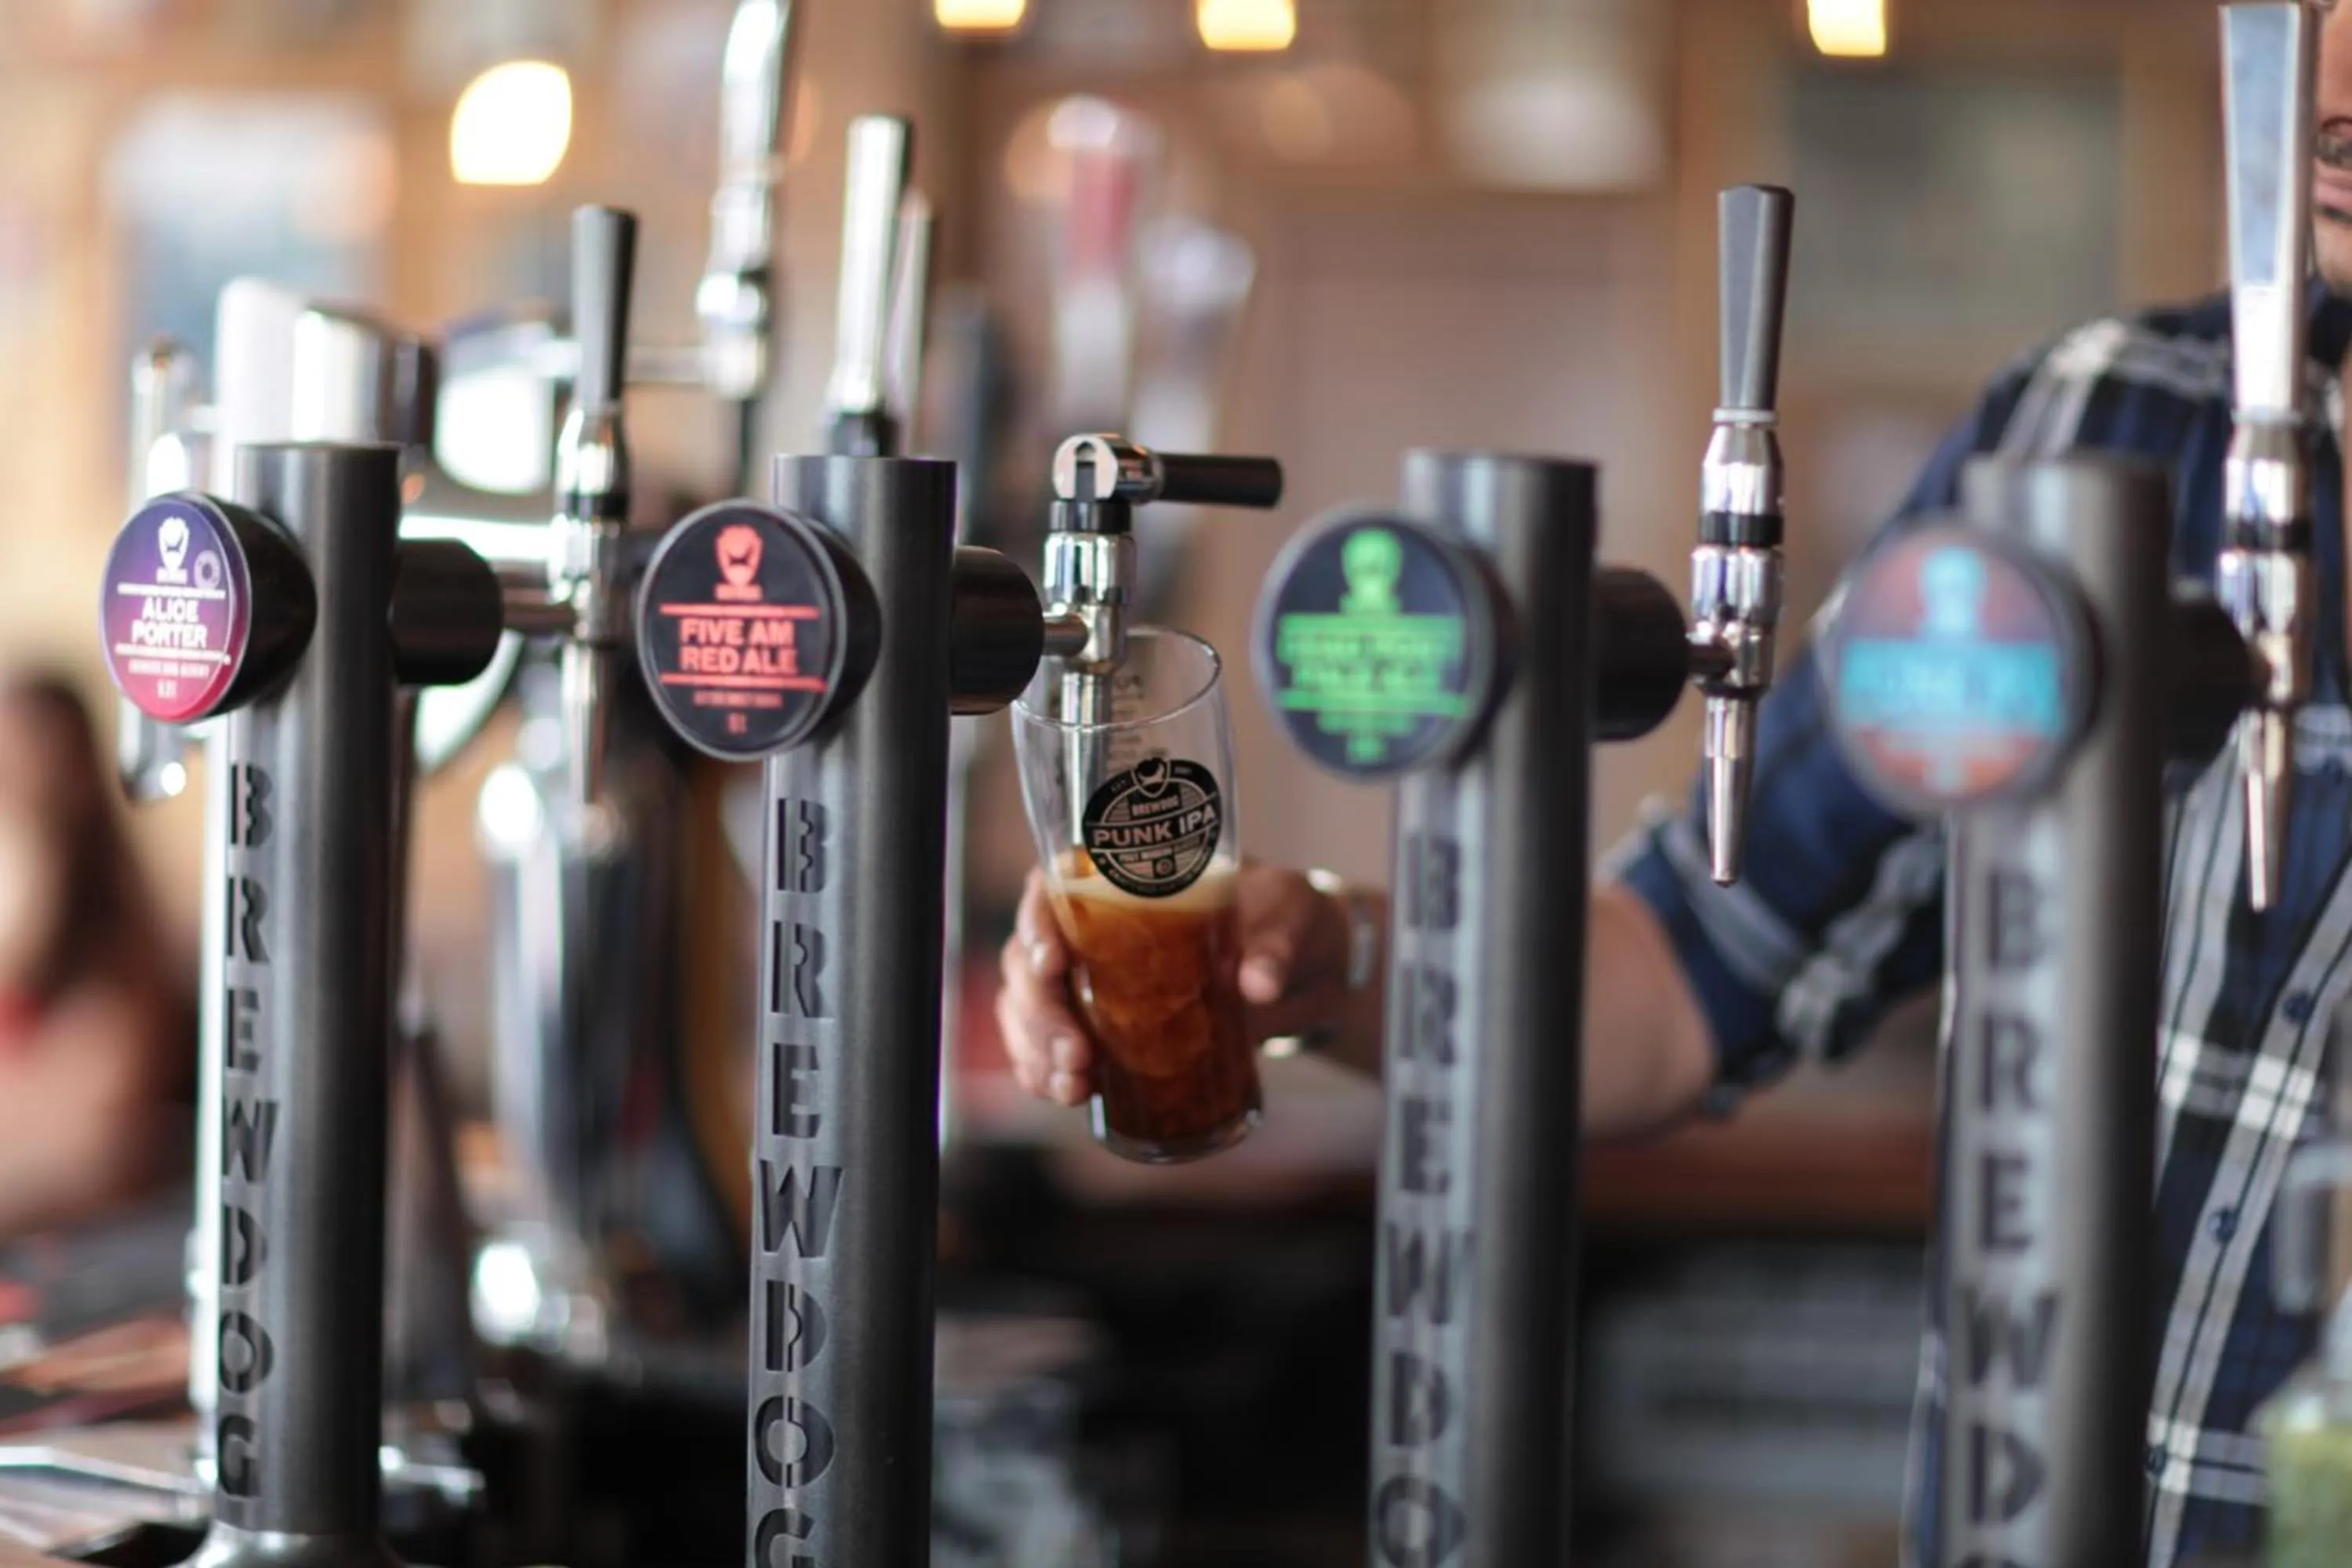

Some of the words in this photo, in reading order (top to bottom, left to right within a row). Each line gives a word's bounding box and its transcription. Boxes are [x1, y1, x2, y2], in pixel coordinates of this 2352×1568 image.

[142, 597, 199, 623] ALICE
[131, 619, 208, 648] PORTER
[680, 619, 743, 645] FIVE
[750, 619, 795, 646] AM
[680, 646, 740, 672] RED
[742, 648, 797, 675] ALE
[1094, 823, 1173, 846] PUNK
[1180, 805, 1217, 833] IPA
[219, 764, 280, 1497] BREWDOG
[754, 797, 844, 1568] BREWDOG
[1957, 867, 2060, 1568] BREWD
